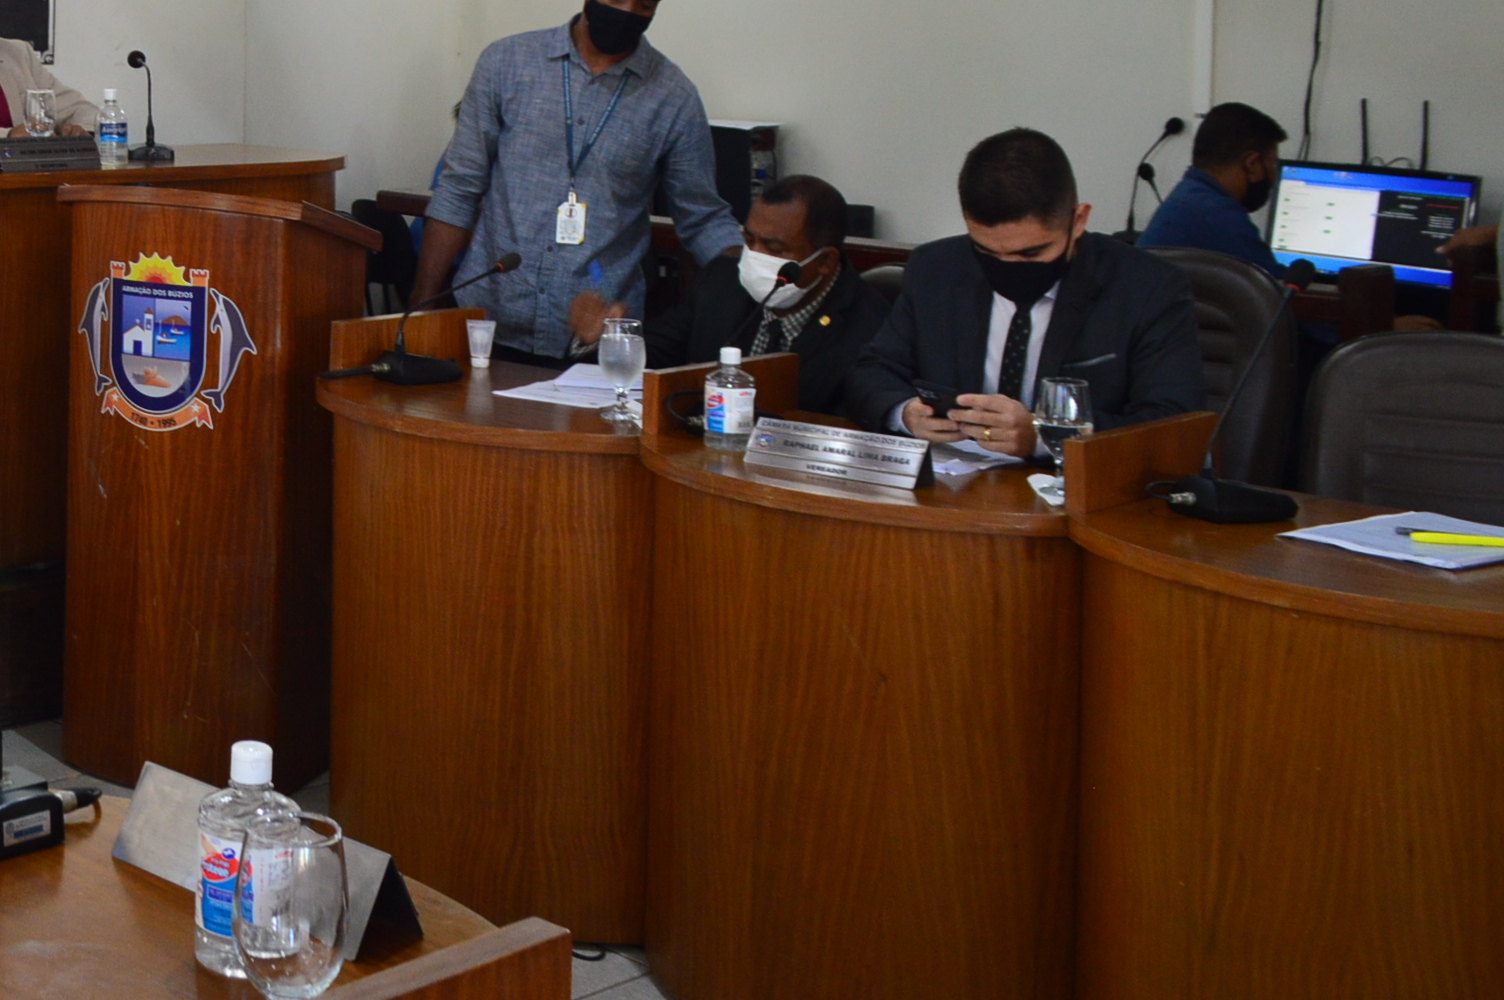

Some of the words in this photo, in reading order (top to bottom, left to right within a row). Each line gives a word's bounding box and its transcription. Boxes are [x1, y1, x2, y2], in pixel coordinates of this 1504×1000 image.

[122, 285, 151, 295] ARMAÇÃO
[152, 288, 167, 297] DOS
[783, 439, 819, 452] RAPHAEL
[822, 445, 857, 458] AMARAL
[857, 450, 879, 461] LIMA
[880, 454, 911, 466] BRAGA
[806, 463, 848, 475] VEREADOR
